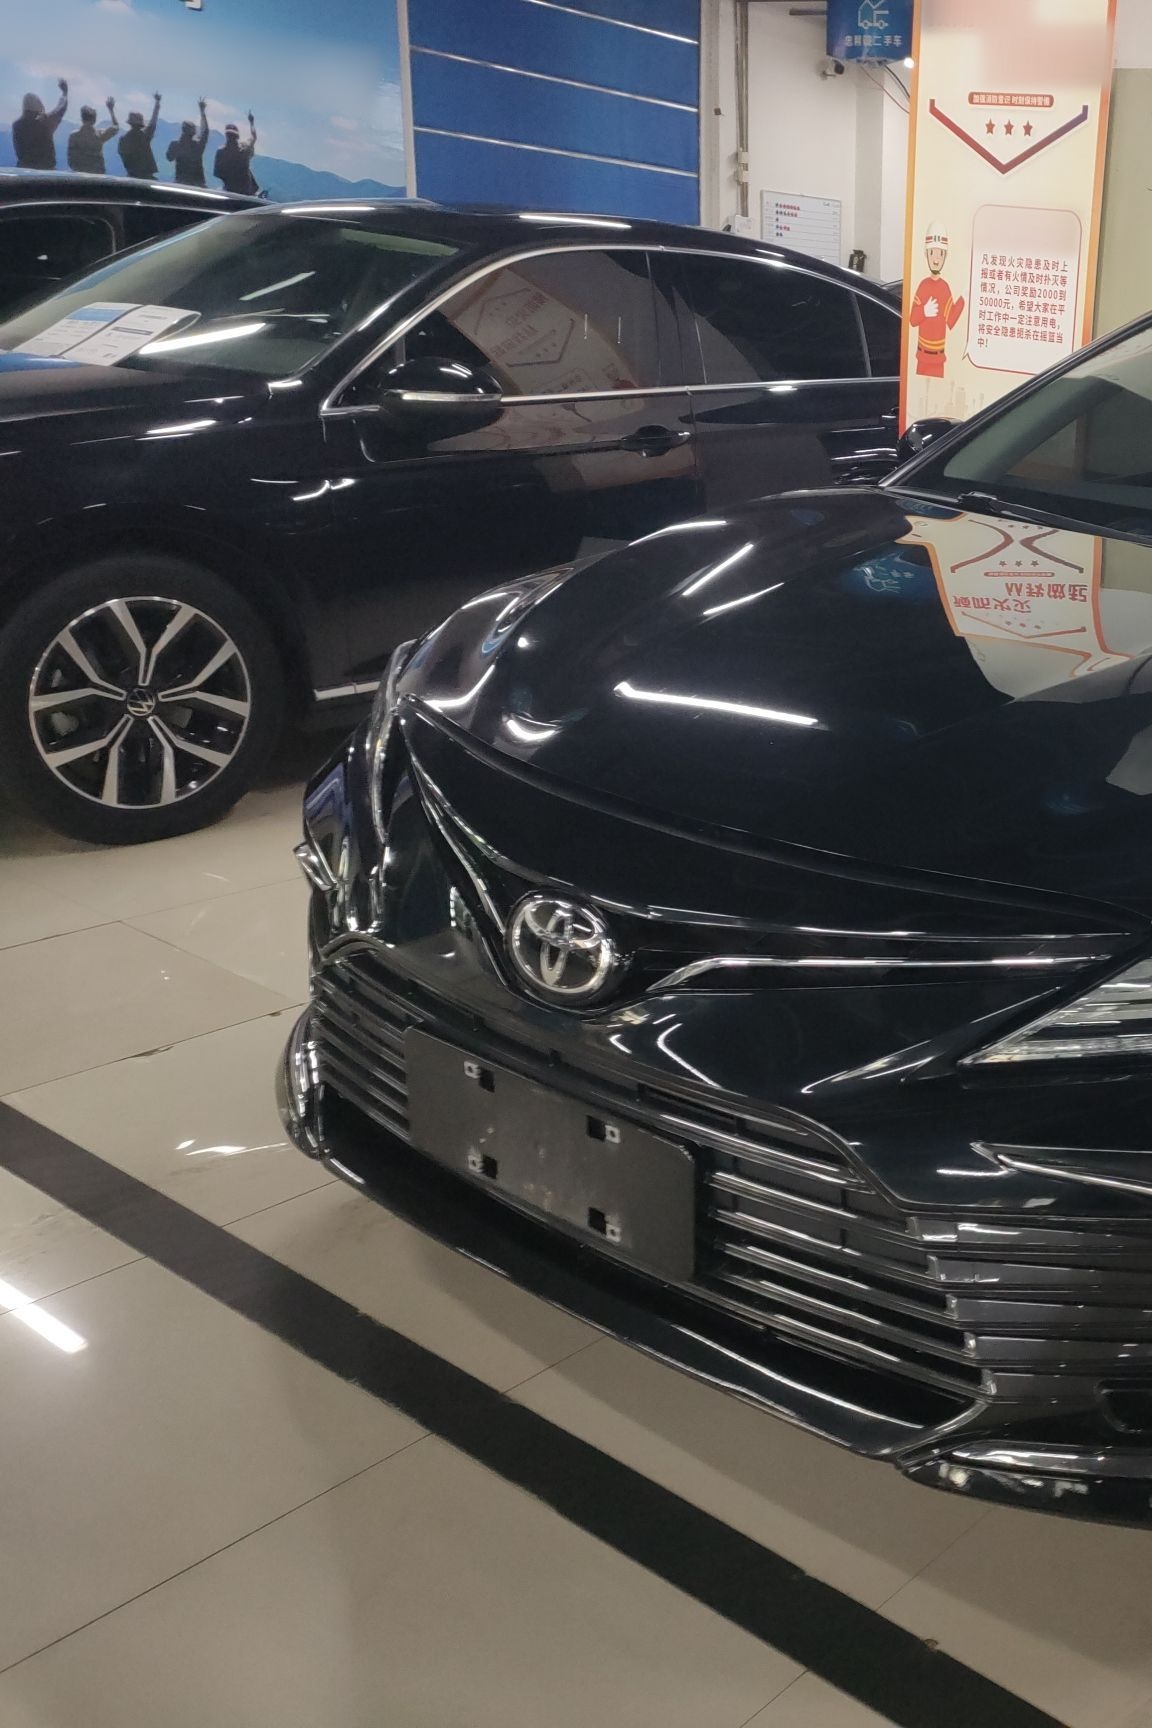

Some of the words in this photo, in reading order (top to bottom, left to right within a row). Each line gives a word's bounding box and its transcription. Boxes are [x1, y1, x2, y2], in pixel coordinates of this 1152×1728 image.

[981, 254, 1068, 272] 凡发现火灾隐患及时上
[980, 268, 1067, 287] 报或者有火情及时扑灭等
[980, 282, 1066, 301] 情况，公司奖励2000到
[979, 297, 1065, 315] 50000元，希望大家在平
[978, 310, 1060, 329] 时工作中一定注意用电，
[978, 324, 1063, 343] 将安全隐患扼杀在摇篮当
